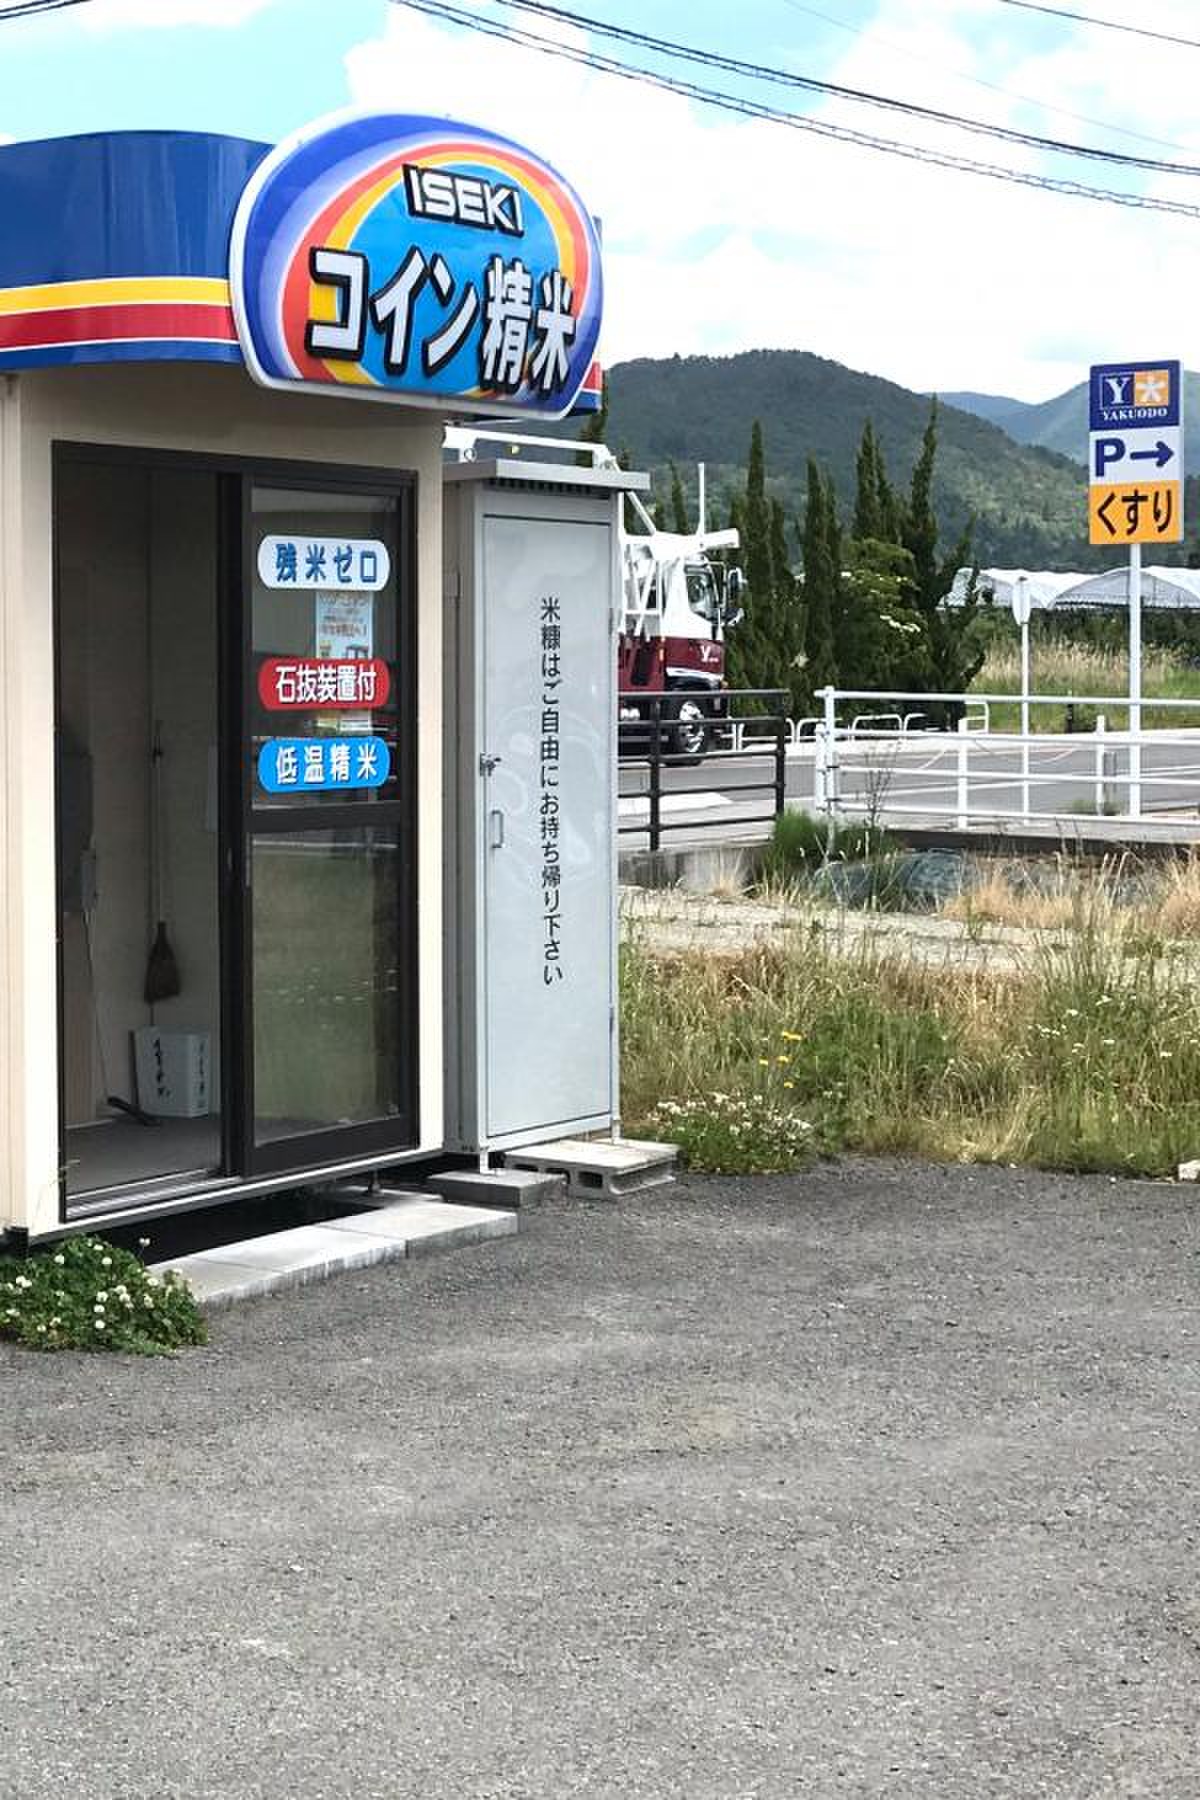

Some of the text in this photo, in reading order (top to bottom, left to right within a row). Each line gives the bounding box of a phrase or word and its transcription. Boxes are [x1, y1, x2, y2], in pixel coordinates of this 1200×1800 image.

[405, 166, 524, 234] ISEKI
[308, 247, 575, 391] コイン精米
[1102, 407, 1168, 422] YAKUODO
[1095, 437, 1126, 478] P
[1097, 489, 1172, 537] くすり
[274, 542, 378, 583] 残米ゼロ
[275, 664, 377, 703] 石抜装置付
[275, 743, 377, 784] 低温精米
[539, 596, 563, 986] 米糠はご自由にお持ち帰り下さい
